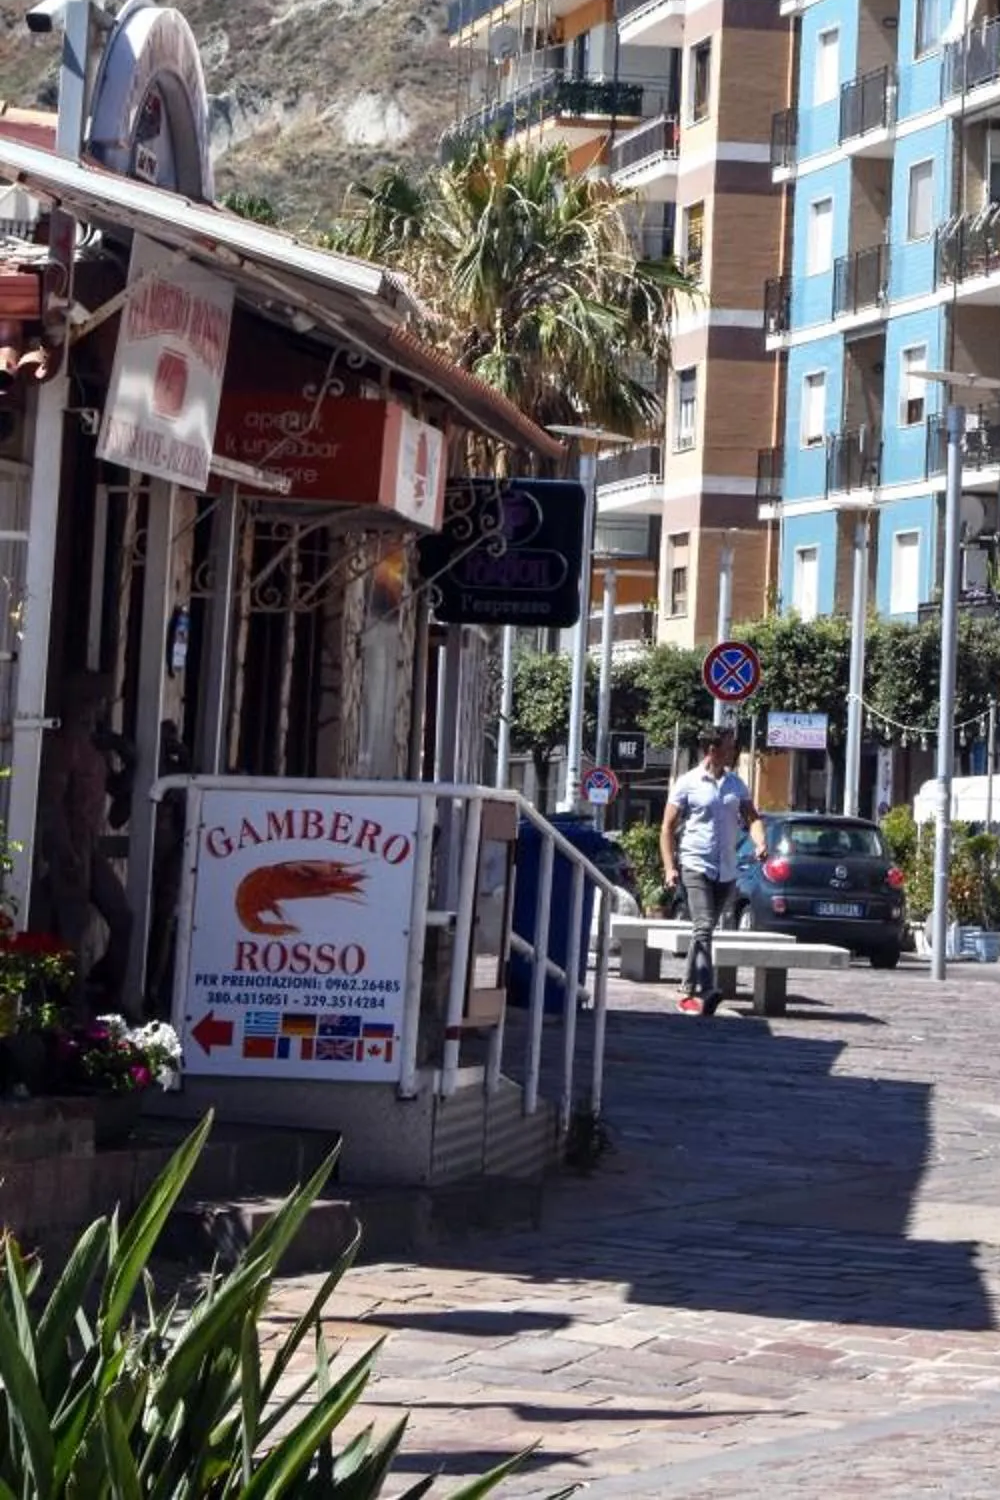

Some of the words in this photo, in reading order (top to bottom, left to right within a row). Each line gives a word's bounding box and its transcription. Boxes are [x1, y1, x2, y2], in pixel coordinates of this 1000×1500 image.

[206, 808, 411, 866] GAMBERO
[234, 940, 366, 975] ROSSO
[194, 974, 219, 986] PER
[221, 974, 321, 989] PRENOTAZIONI:
[325, 977, 400, 993] 0962.26485
